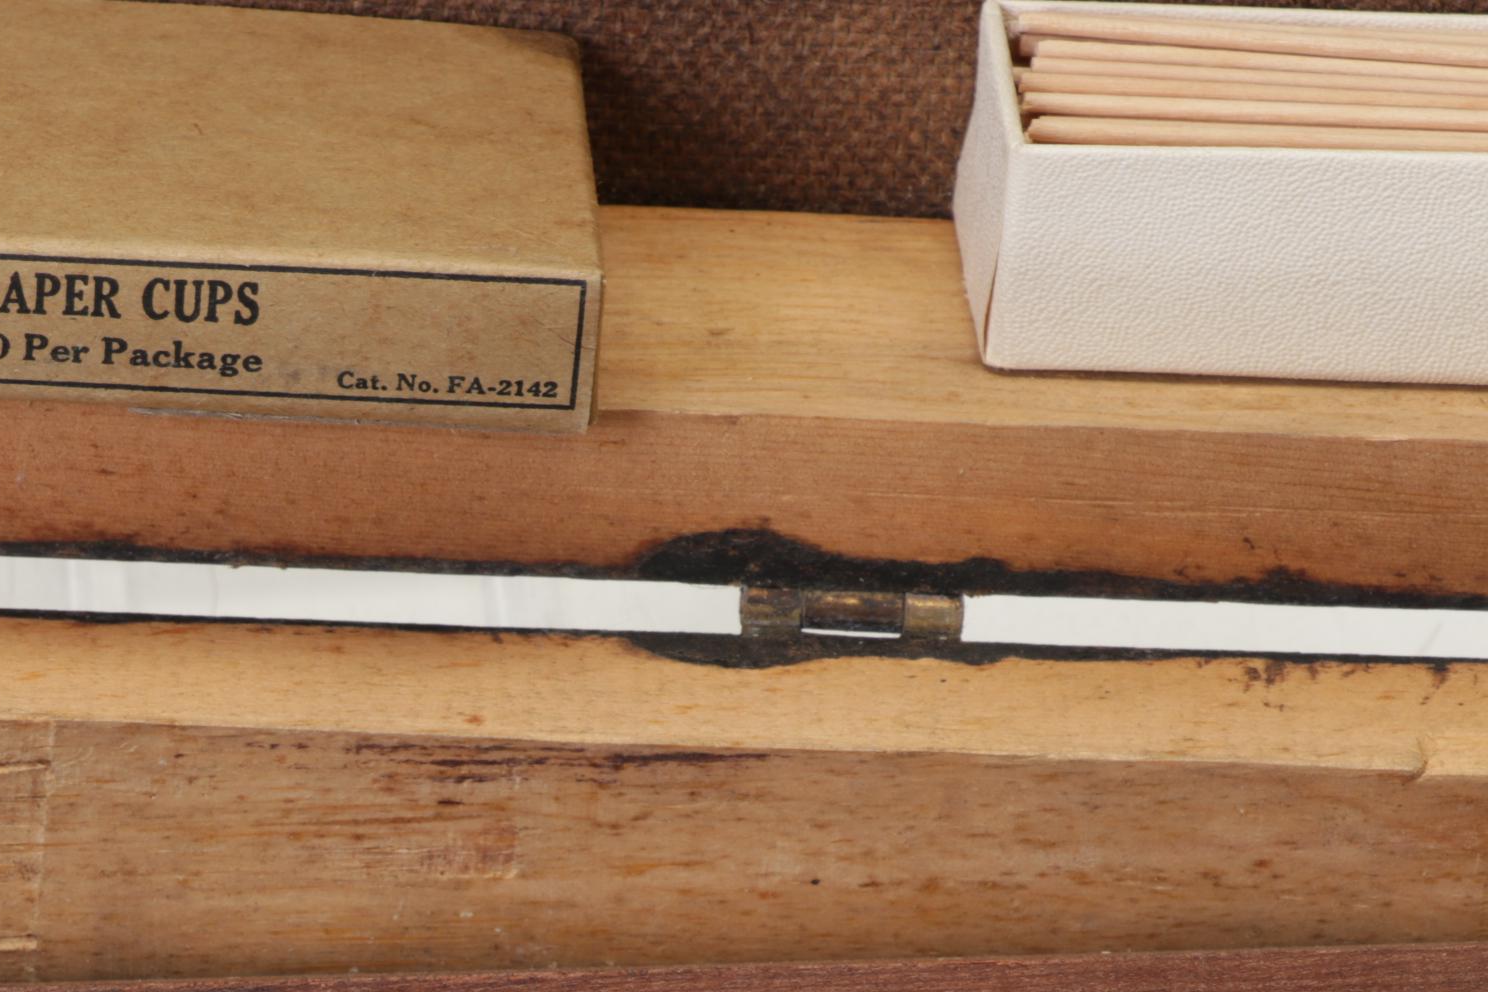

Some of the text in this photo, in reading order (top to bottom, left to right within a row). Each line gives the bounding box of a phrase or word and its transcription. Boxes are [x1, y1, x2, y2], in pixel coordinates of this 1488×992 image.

[141, 277, 261, 327] CUPS
[22, 332, 90, 364] Per
[100, 336, 264, 378] Package
[336, 370, 559, 399] Cat. No. FA-2142
